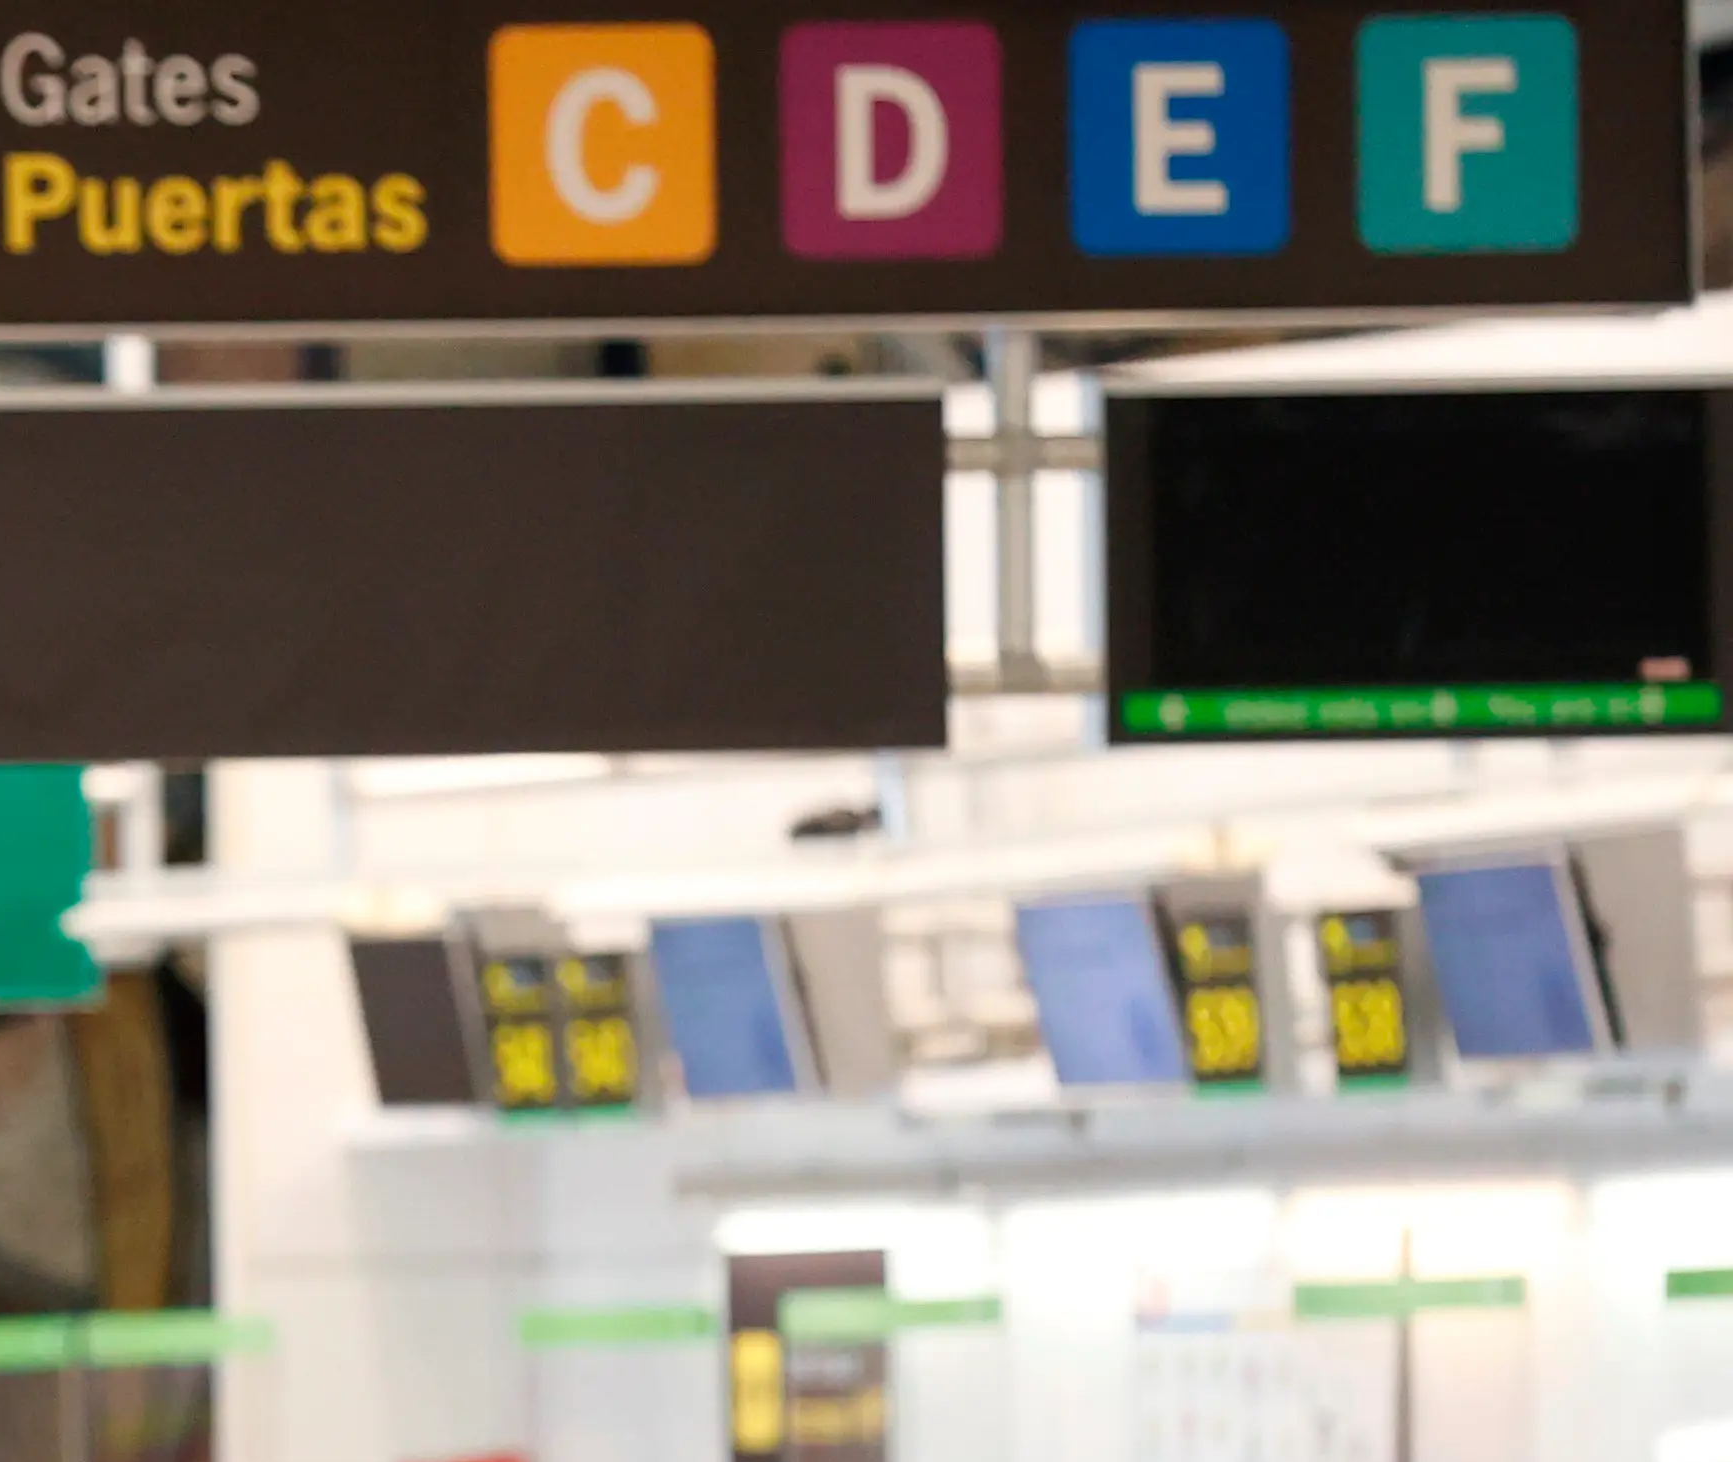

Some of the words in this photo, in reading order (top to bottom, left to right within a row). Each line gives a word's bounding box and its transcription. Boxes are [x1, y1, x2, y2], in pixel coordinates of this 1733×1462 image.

[0, 32, 260, 127] Gates
[545, 66, 660, 224] C
[835, 64, 949, 219] D
[1134, 61, 1229, 215] E
[1421, 57, 1517, 212] F
[3, 151, 427, 254] Puertas
